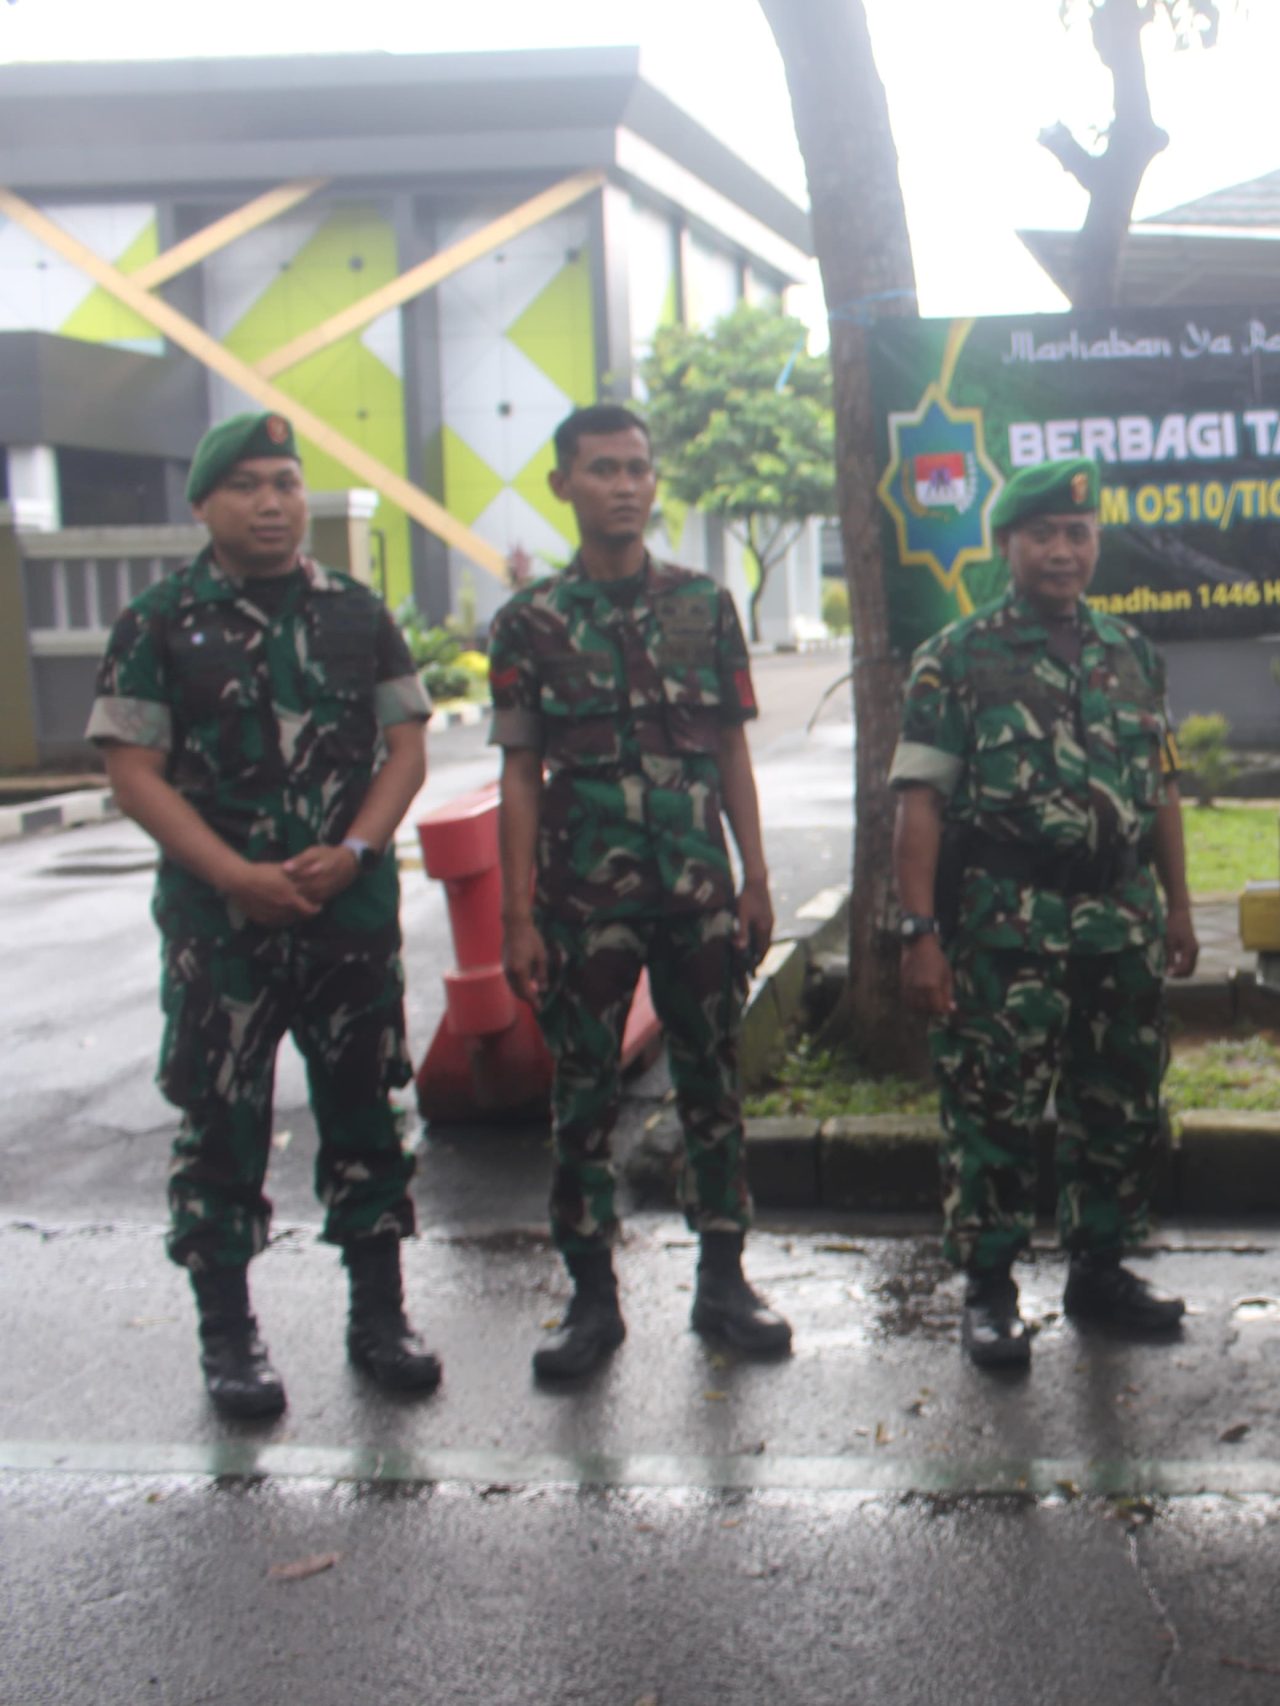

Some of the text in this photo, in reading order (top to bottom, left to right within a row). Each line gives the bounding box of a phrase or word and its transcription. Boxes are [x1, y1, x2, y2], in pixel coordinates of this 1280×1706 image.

[1002, 327, 1171, 365] Marhaban
[1180, 321, 1233, 359] Ya
[1008, 412, 1236, 466] BERBAGI
[1086, 586, 1192, 614] madhan
[1198, 580, 1261, 608] 1446
